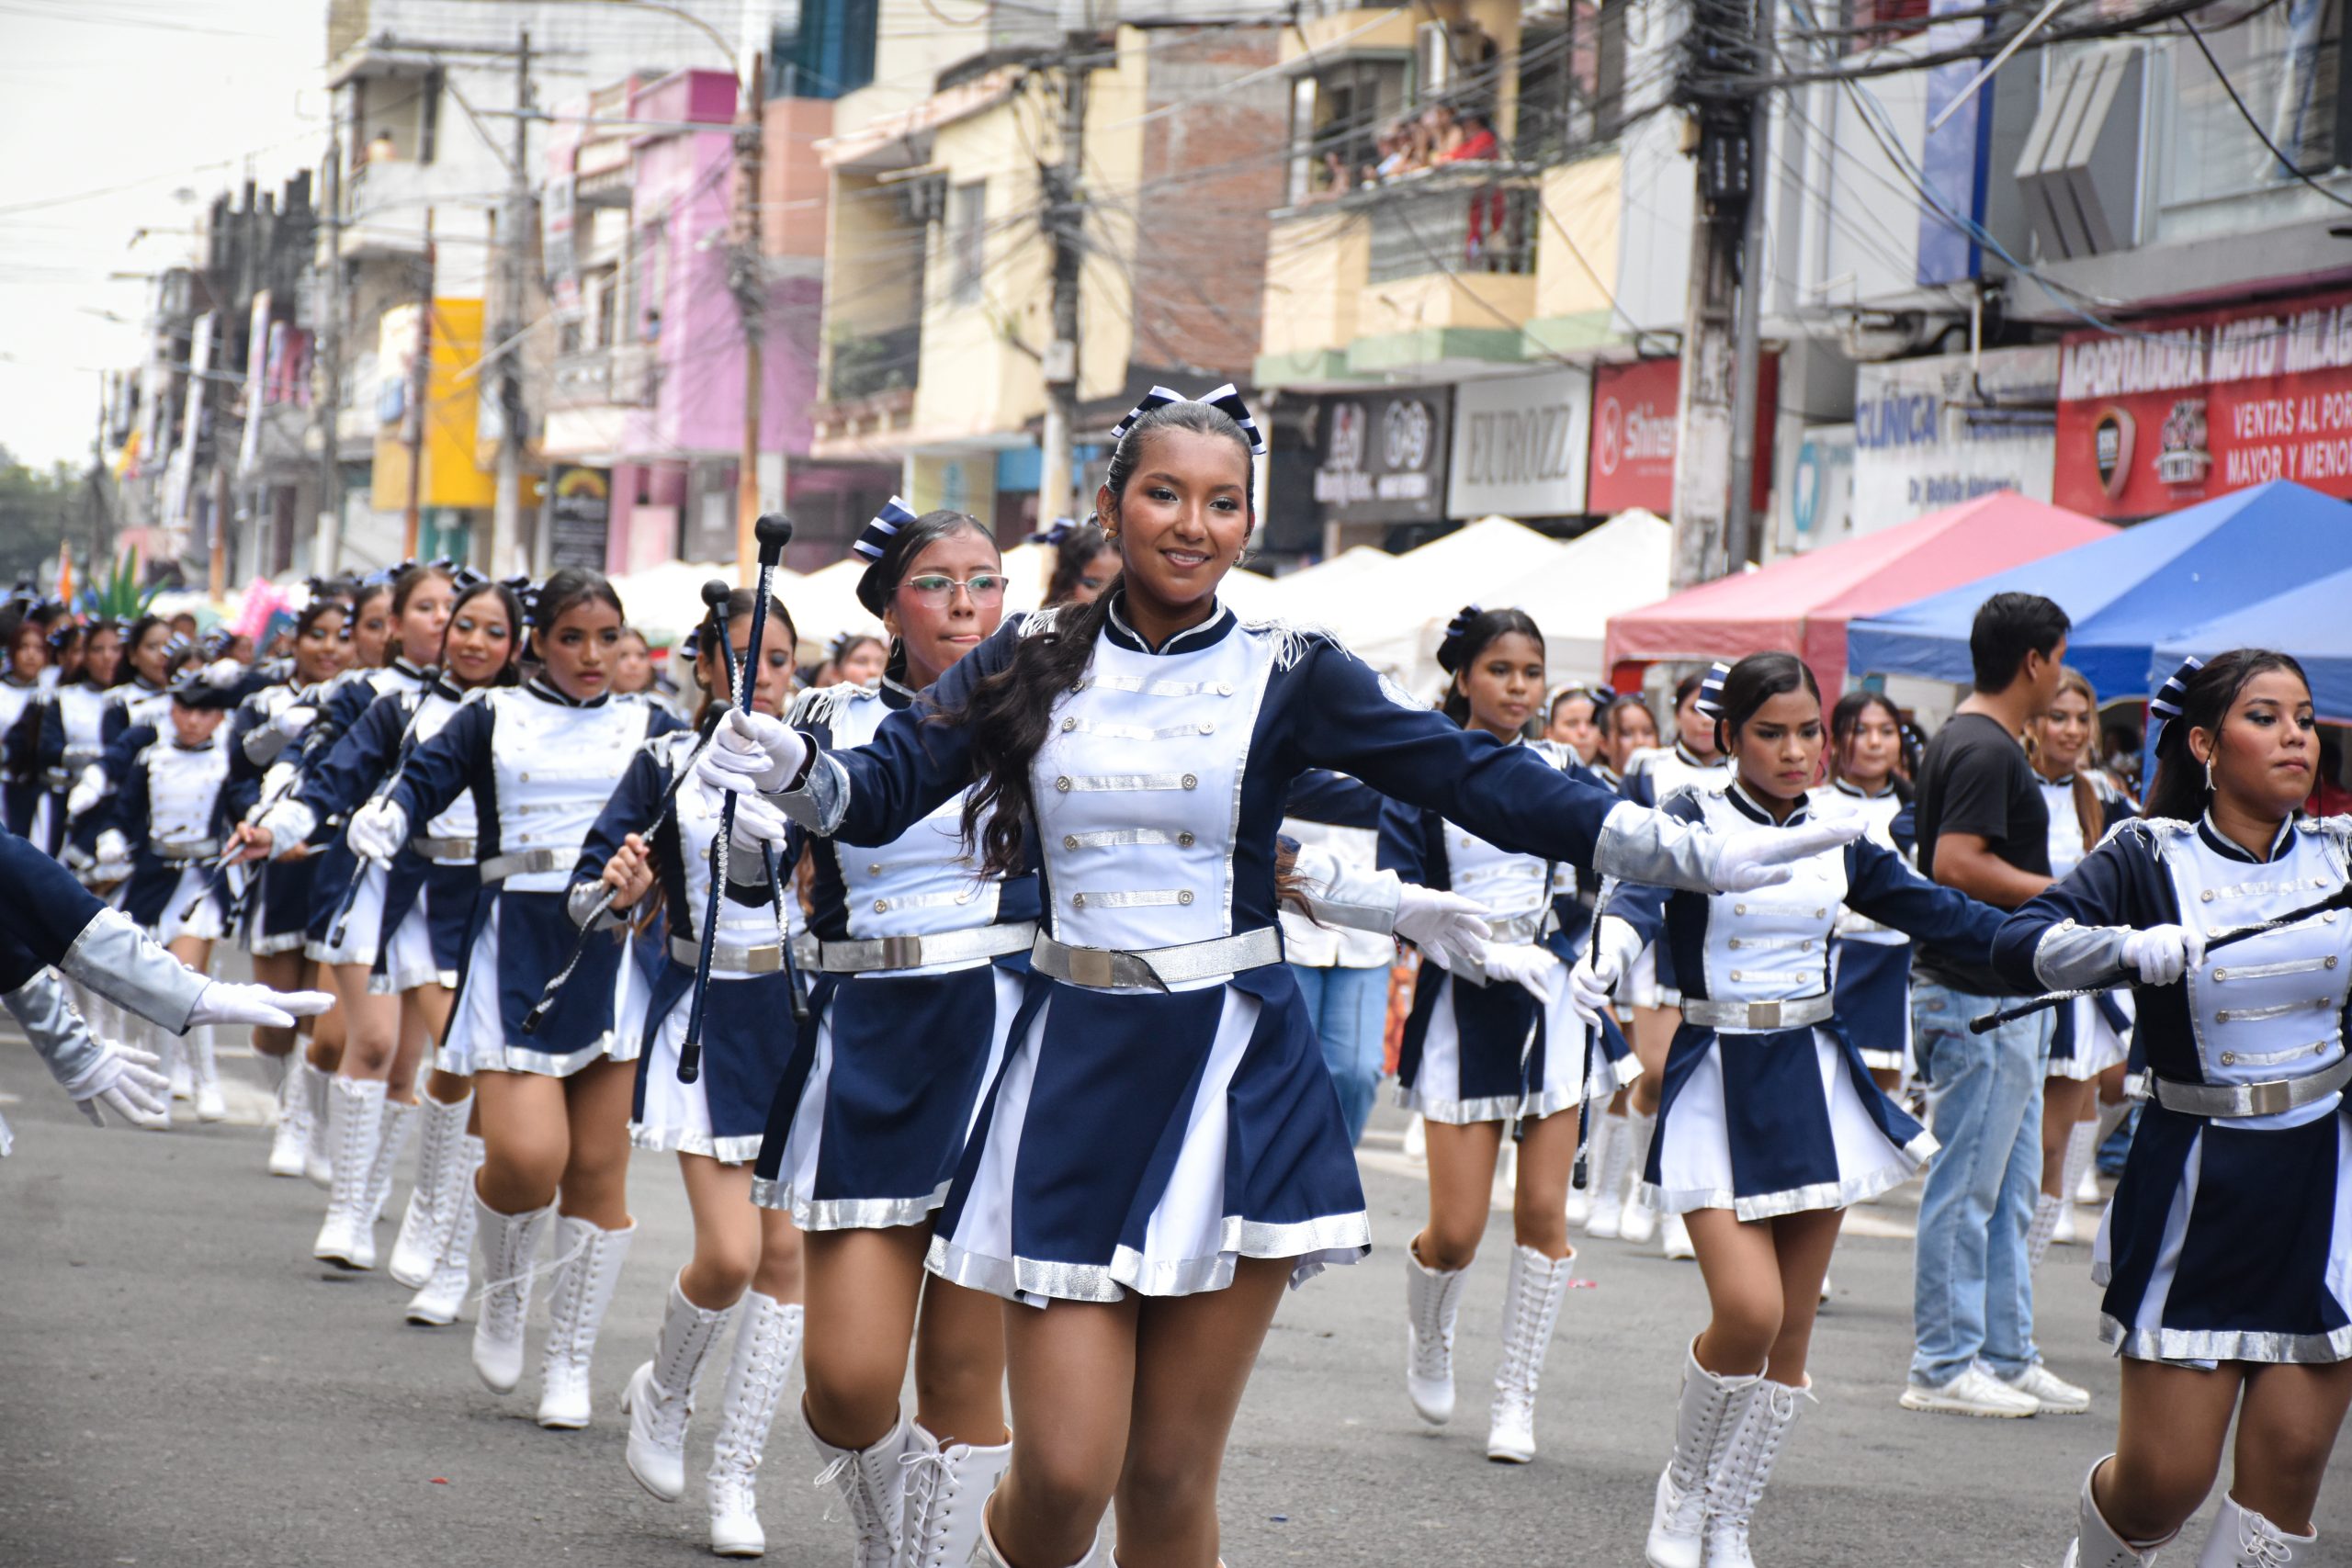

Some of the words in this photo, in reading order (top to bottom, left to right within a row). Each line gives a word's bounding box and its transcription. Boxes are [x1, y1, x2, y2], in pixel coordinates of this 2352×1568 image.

[2209, 316, 2278, 383] MOTO
[2233, 396, 2294, 440] VENTAS
[2298, 395, 2318, 434] AL
[2226, 445, 2282, 485] MAYOR
[2286, 443, 2299, 480] Y
